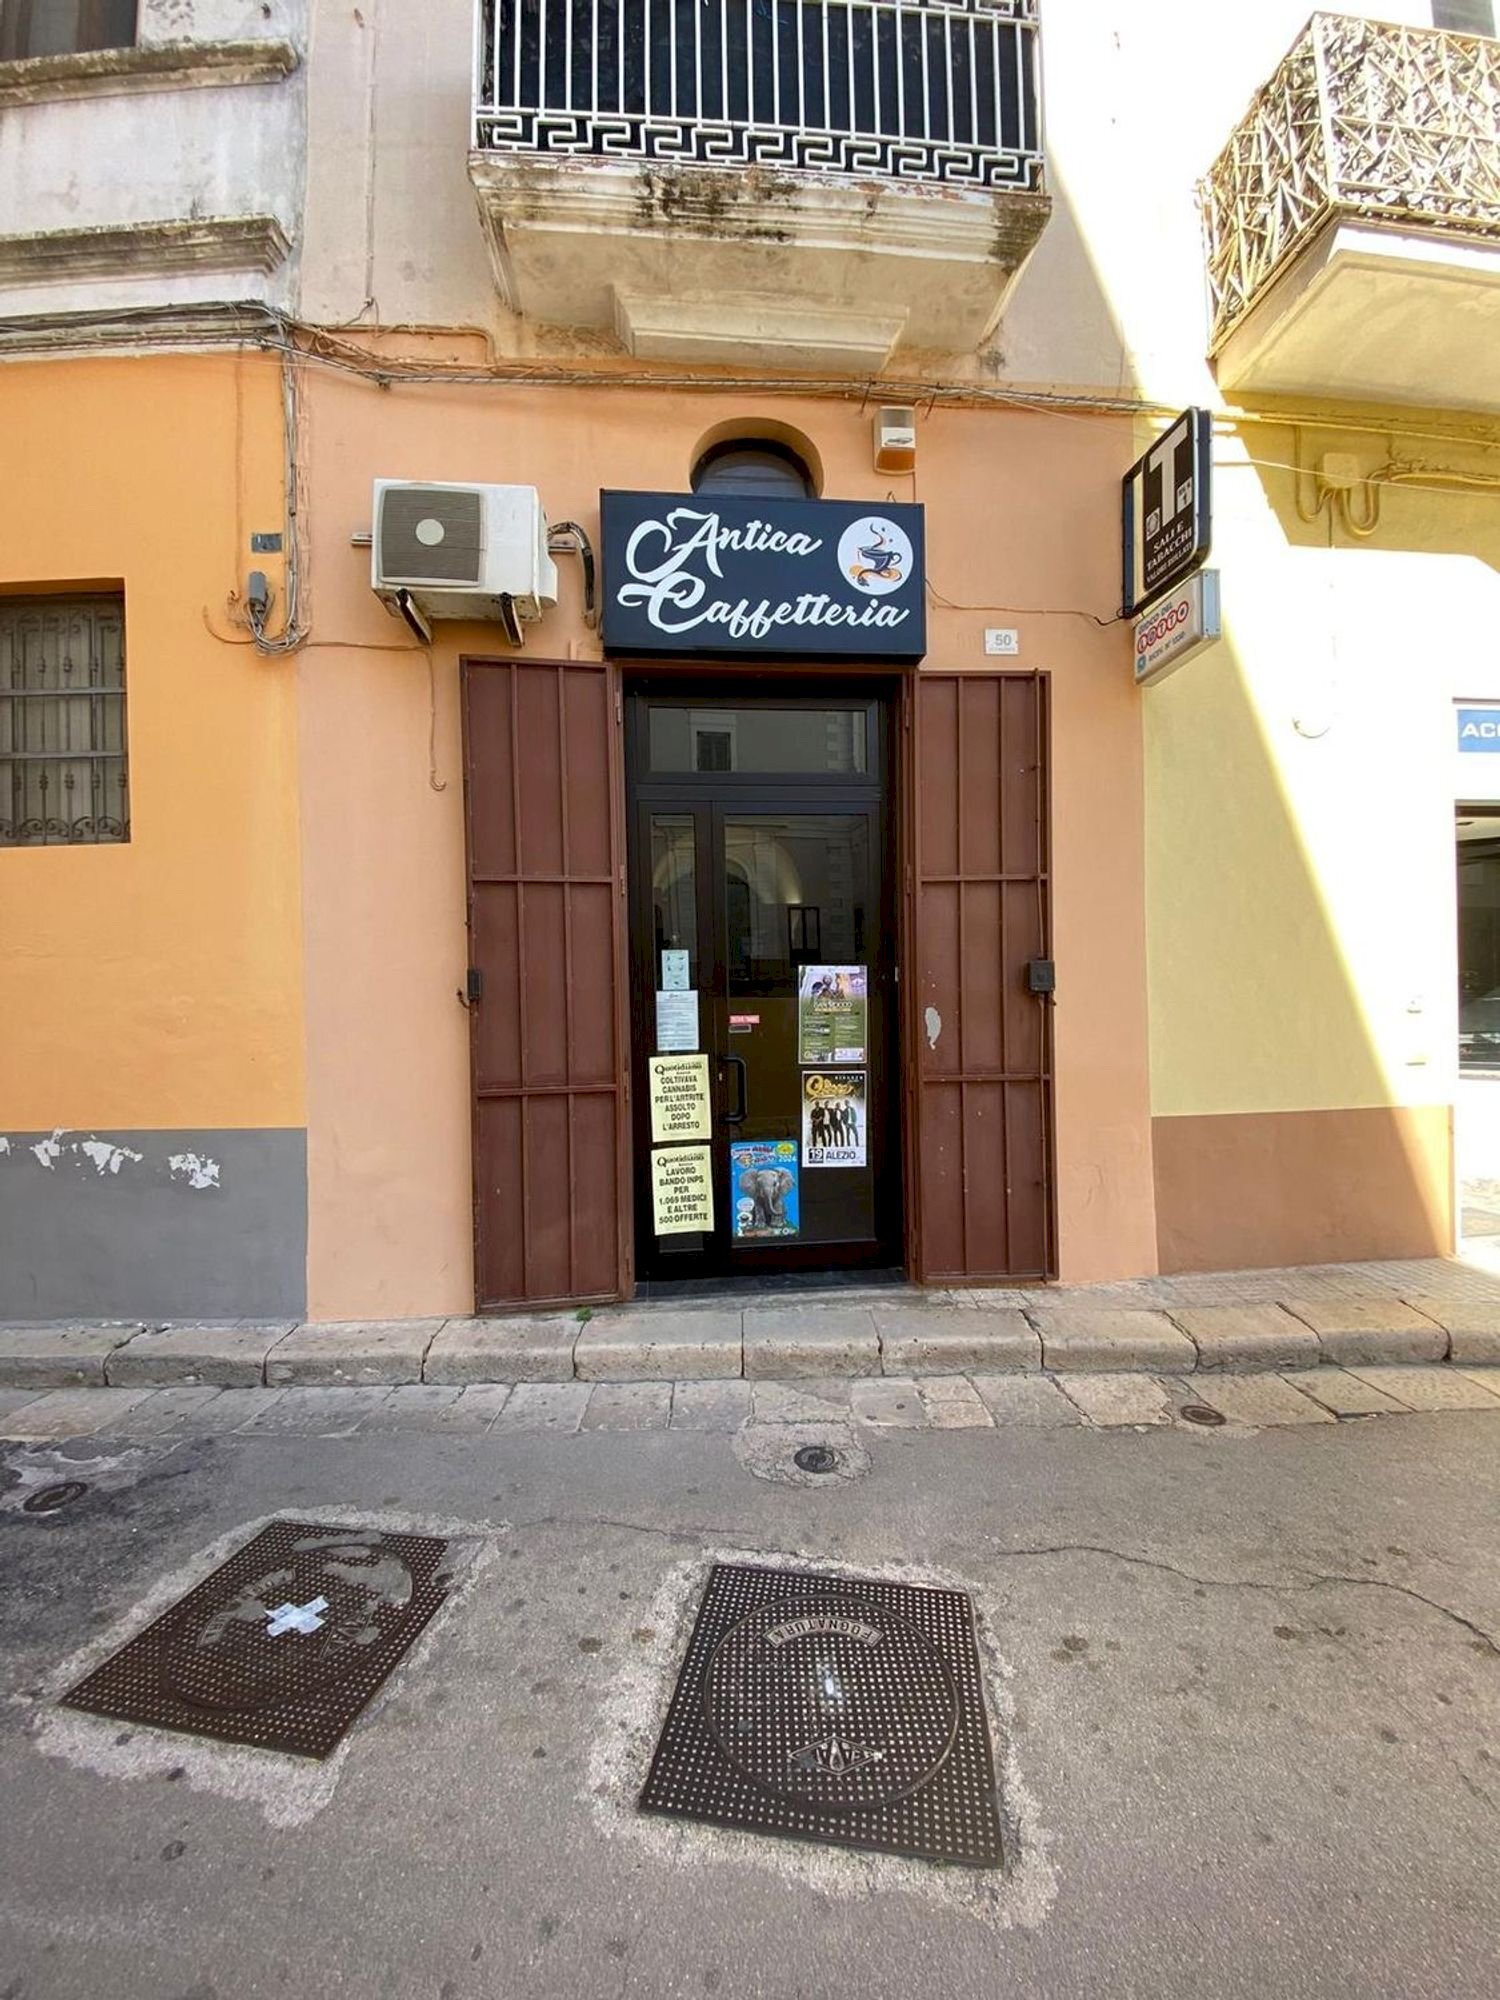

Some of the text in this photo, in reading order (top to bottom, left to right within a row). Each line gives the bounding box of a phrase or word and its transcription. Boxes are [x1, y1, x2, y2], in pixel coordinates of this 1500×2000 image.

[1149, 418, 1188, 528] T
[625, 507, 823, 582] Antica
[1146, 526, 1192, 572] TABACCHI
[616, 571, 910, 638] Caffetteria
[995, 634, 1012, 646] 50
[1461, 722, 1500, 738] AC
[660, 1075, 697, 1084] COLTIVAVA
[662, 1084, 697, 1094] CANNABIS
[665, 1102, 696, 1112] ASSOLTO
[671, 1112, 691, 1121] DOPO
[662, 1121, 700, 1131] L'ARRESTO
[810, 1149, 856, 1160] 19 ALEZIO
[666, 1166, 696, 1176] LAVORO
[659, 1175, 704, 1186] BANDO INPS
[673, 1186, 689, 1194] PER
[680, 1194, 707, 1203] MEDICI
[667, 1203, 697, 1214] E ALTRE
[659, 1213, 708, 1224] 500 OFFERTE
[773, 1618, 873, 1641] FOGNATURA
